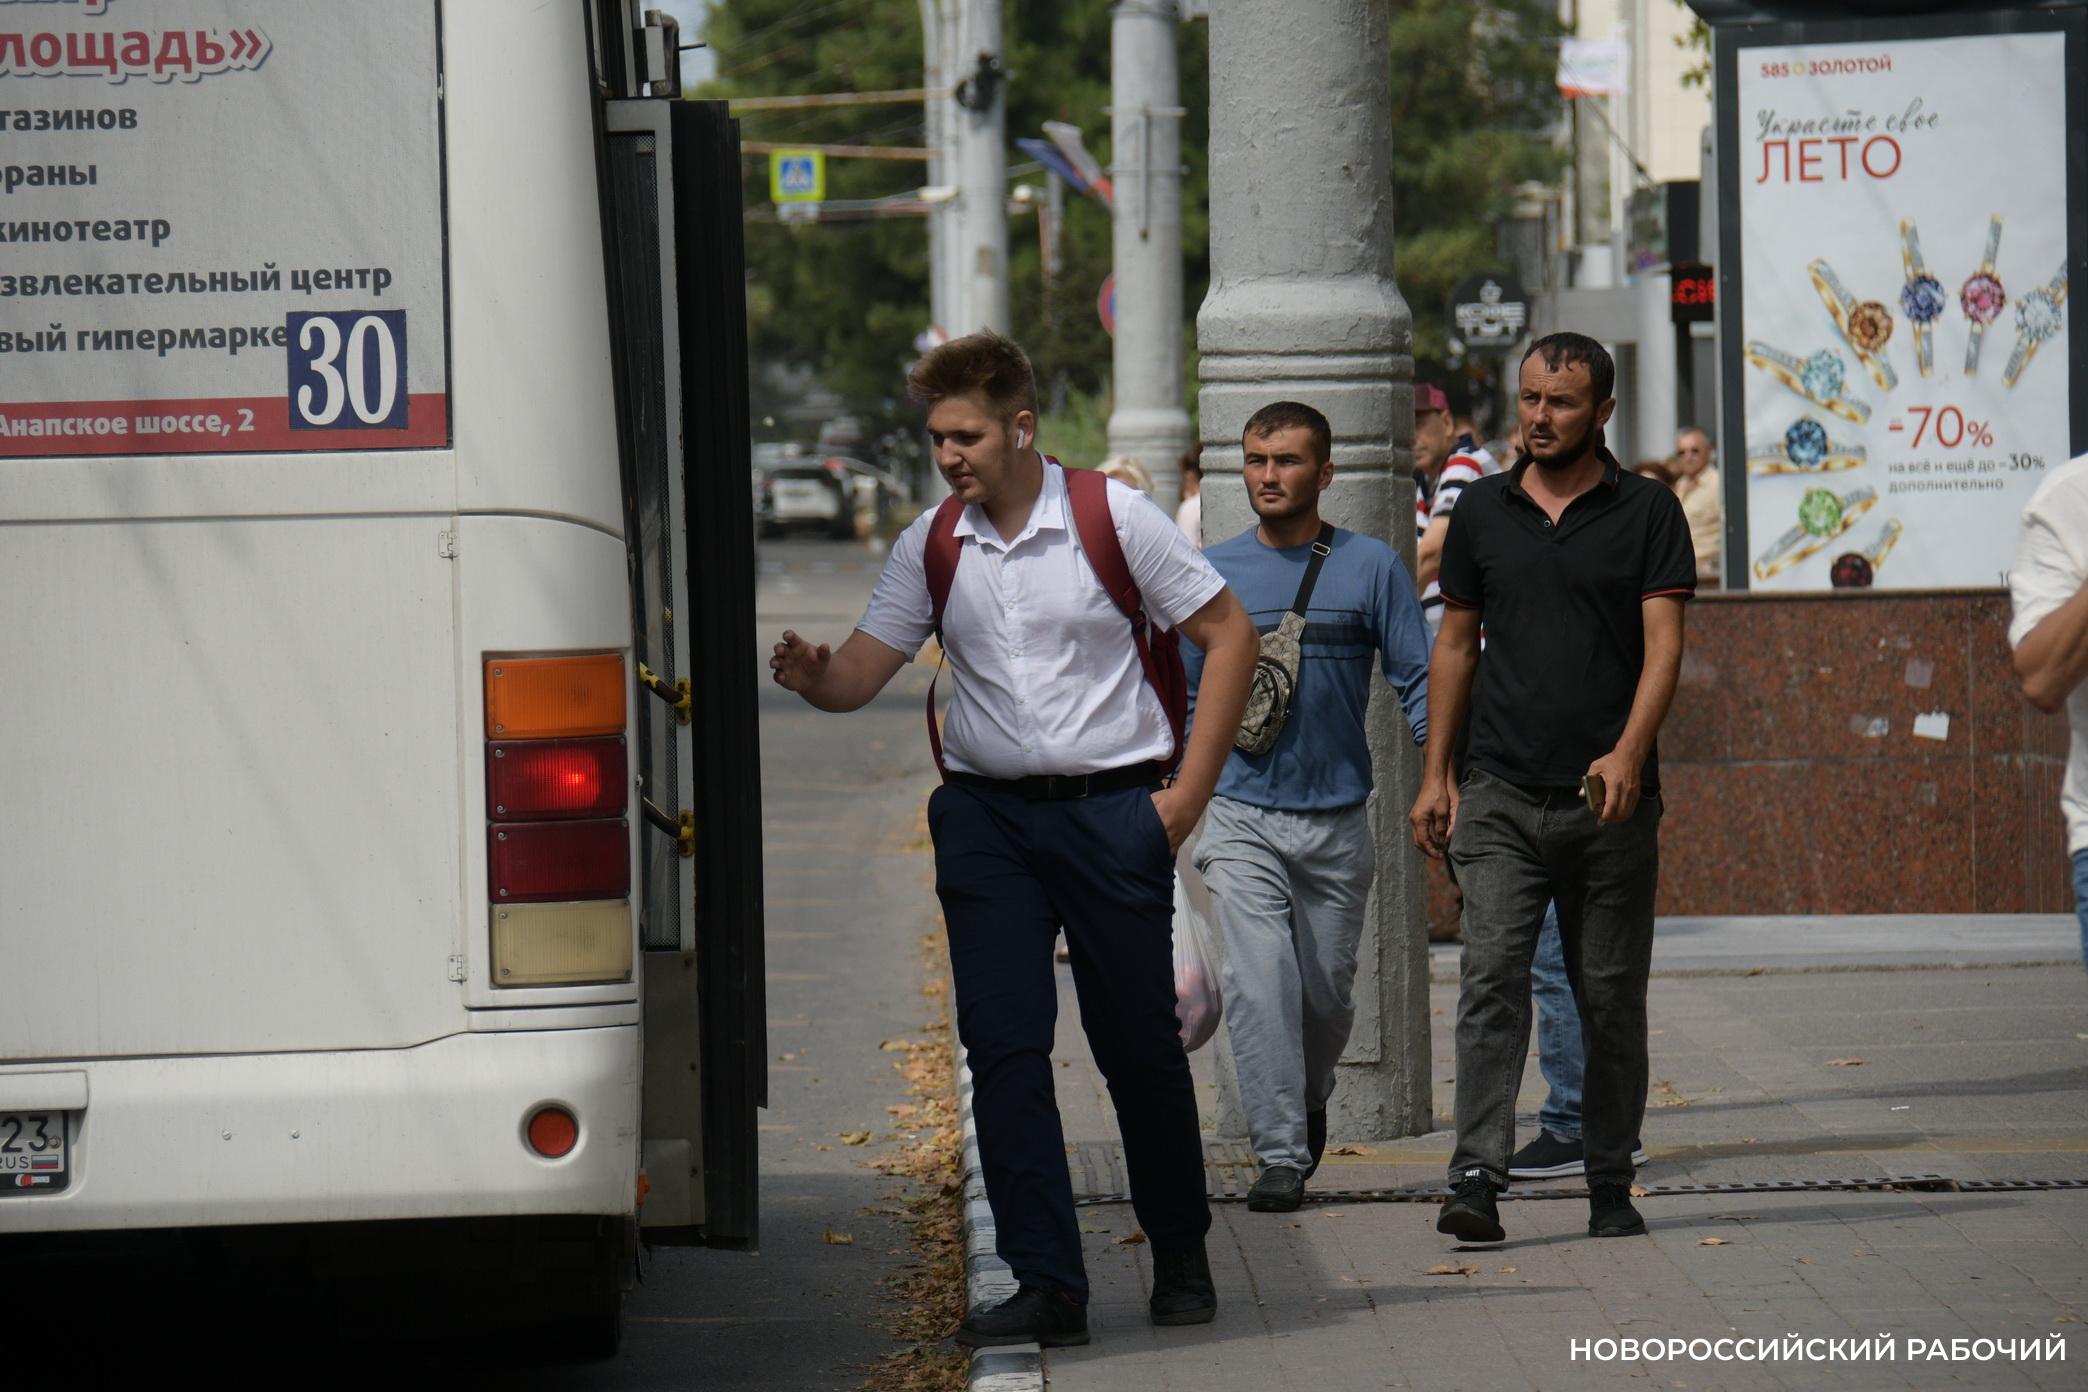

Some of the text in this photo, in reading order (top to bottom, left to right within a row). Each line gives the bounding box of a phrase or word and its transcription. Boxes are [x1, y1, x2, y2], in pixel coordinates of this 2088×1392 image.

[1761, 54, 1893, 78] 585 ЗОЛОТОЙ
[1756, 134, 1902, 184] ЛЕТО
[0, 165, 97, 194] раны
[291, 266, 392, 294] центр
[77, 322, 288, 358] гипермарке
[297, 315, 398, 426] 30
[135, 413, 232, 437] шоссе,
[237, 408, 255, 432] 2
[1888, 478, 2004, 494] дополнительно
[1, 1115, 49, 1153] 23
[0, 1155, 29, 1169] US
